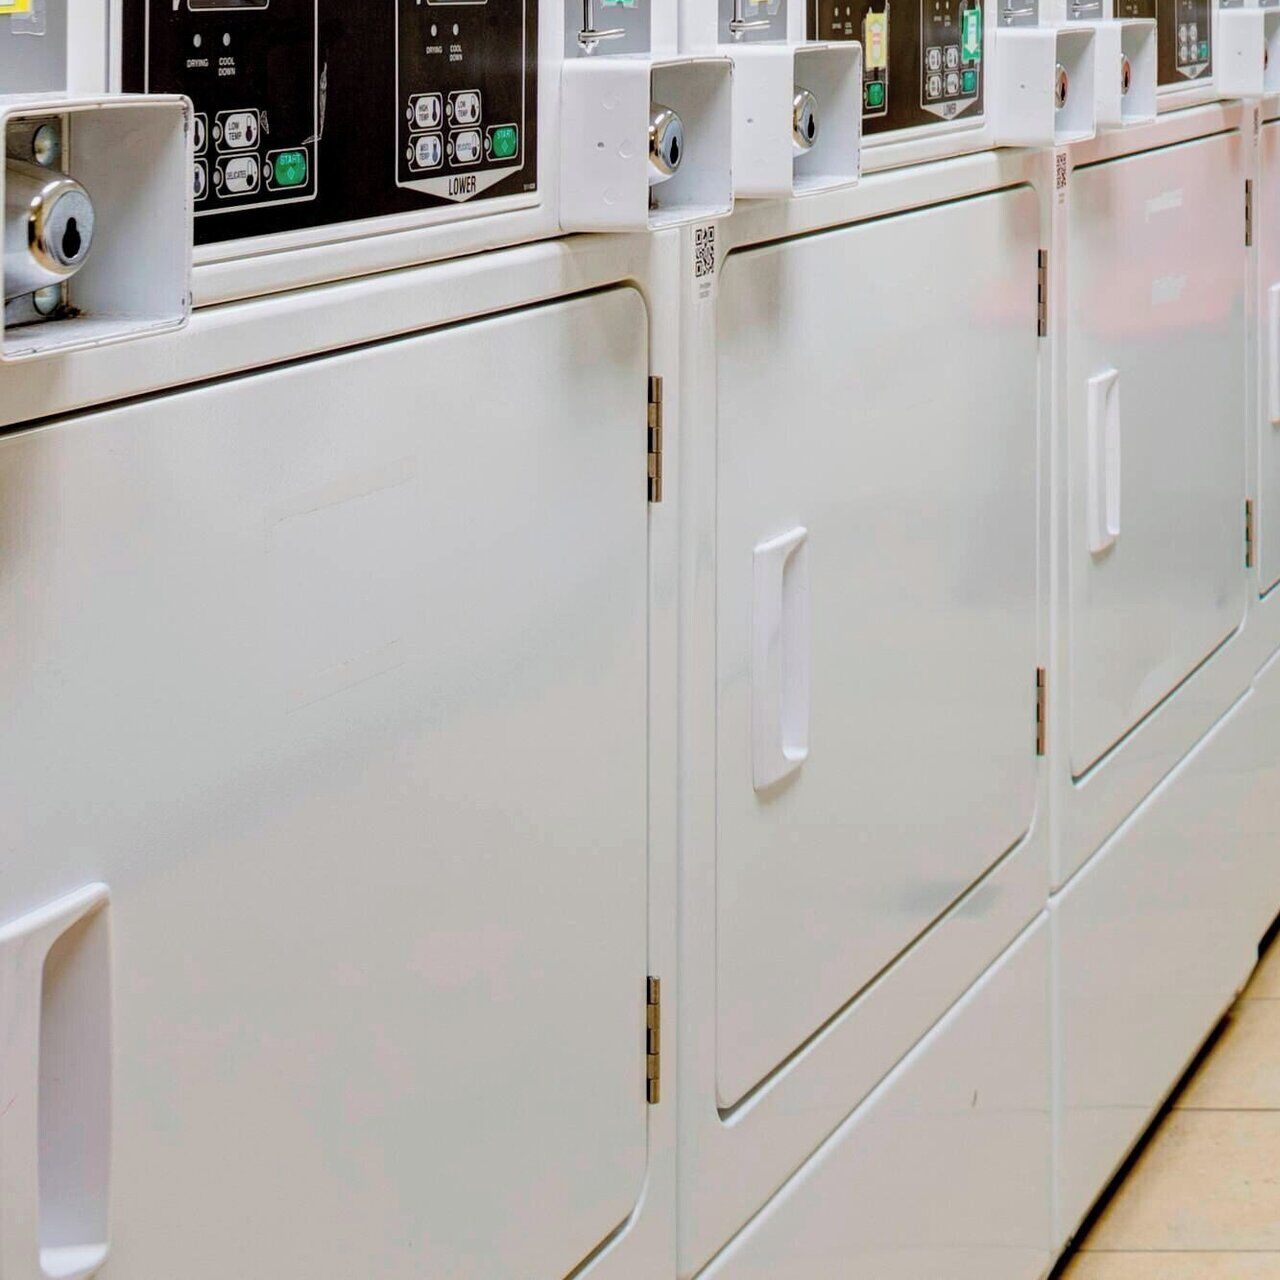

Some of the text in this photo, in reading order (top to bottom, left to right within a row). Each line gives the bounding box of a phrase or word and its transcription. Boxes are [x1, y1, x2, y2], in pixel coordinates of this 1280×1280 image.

[228, 122, 239, 131] LOW
[228, 132, 242, 141] TEMP
[449, 176, 476, 196] LOWER
